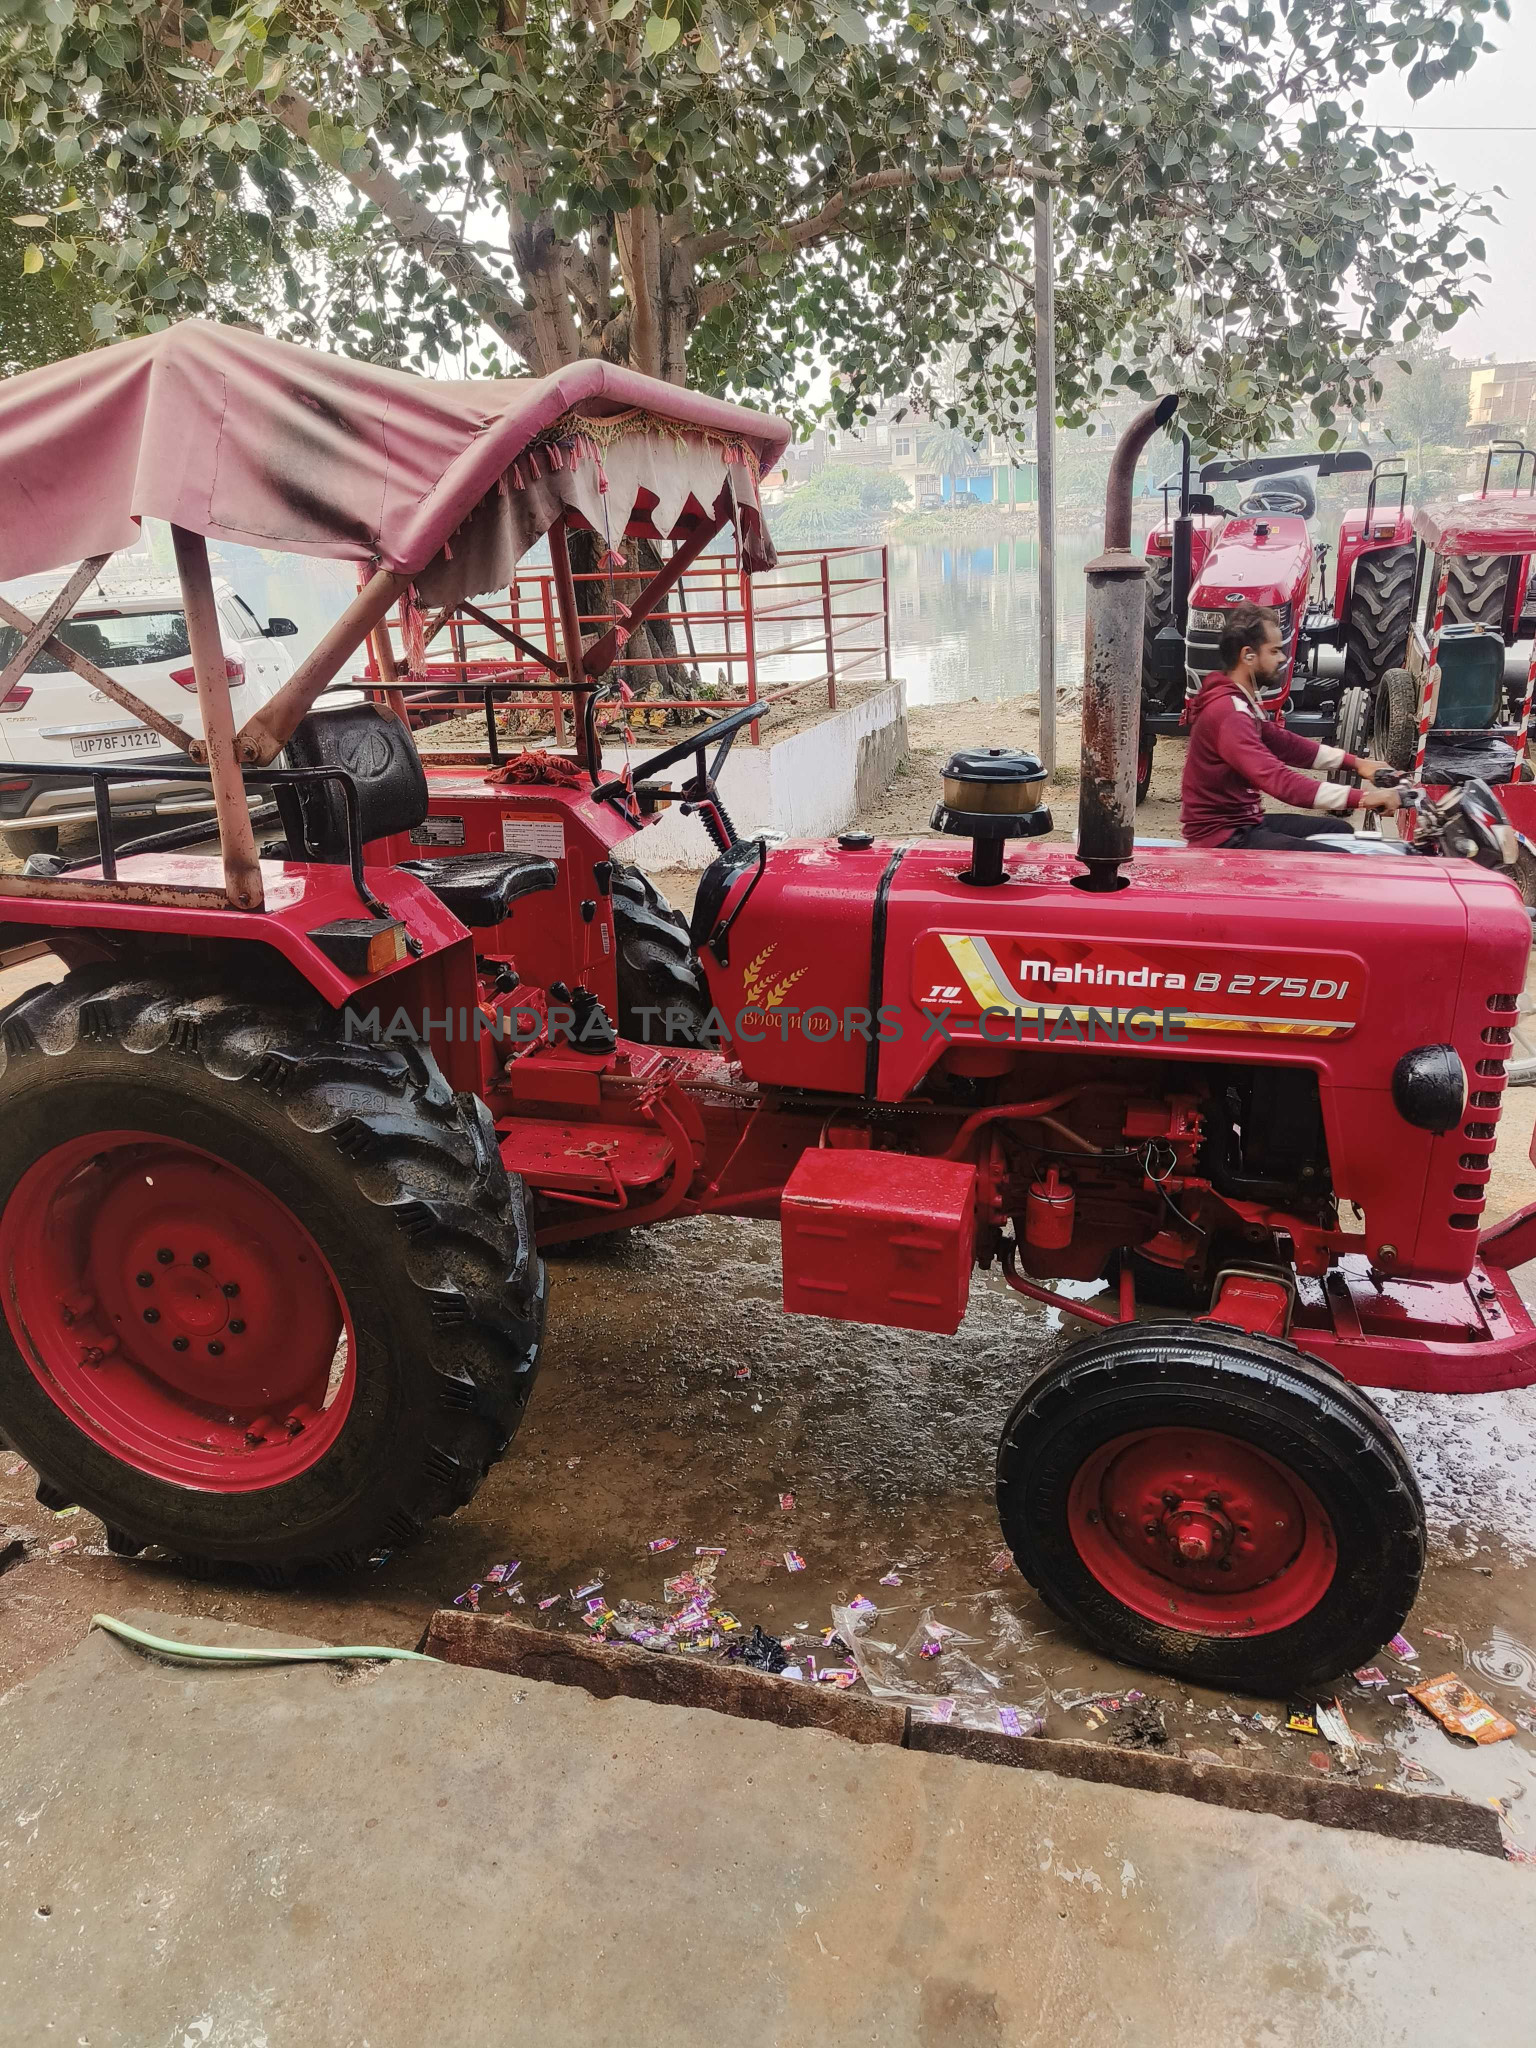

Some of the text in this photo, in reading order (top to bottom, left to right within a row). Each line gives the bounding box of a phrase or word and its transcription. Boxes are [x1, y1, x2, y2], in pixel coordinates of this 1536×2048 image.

[79, 732, 159, 753] UP78FJ1212
[929, 985, 962, 998] TU
[1193, 972, 1222, 992] B
